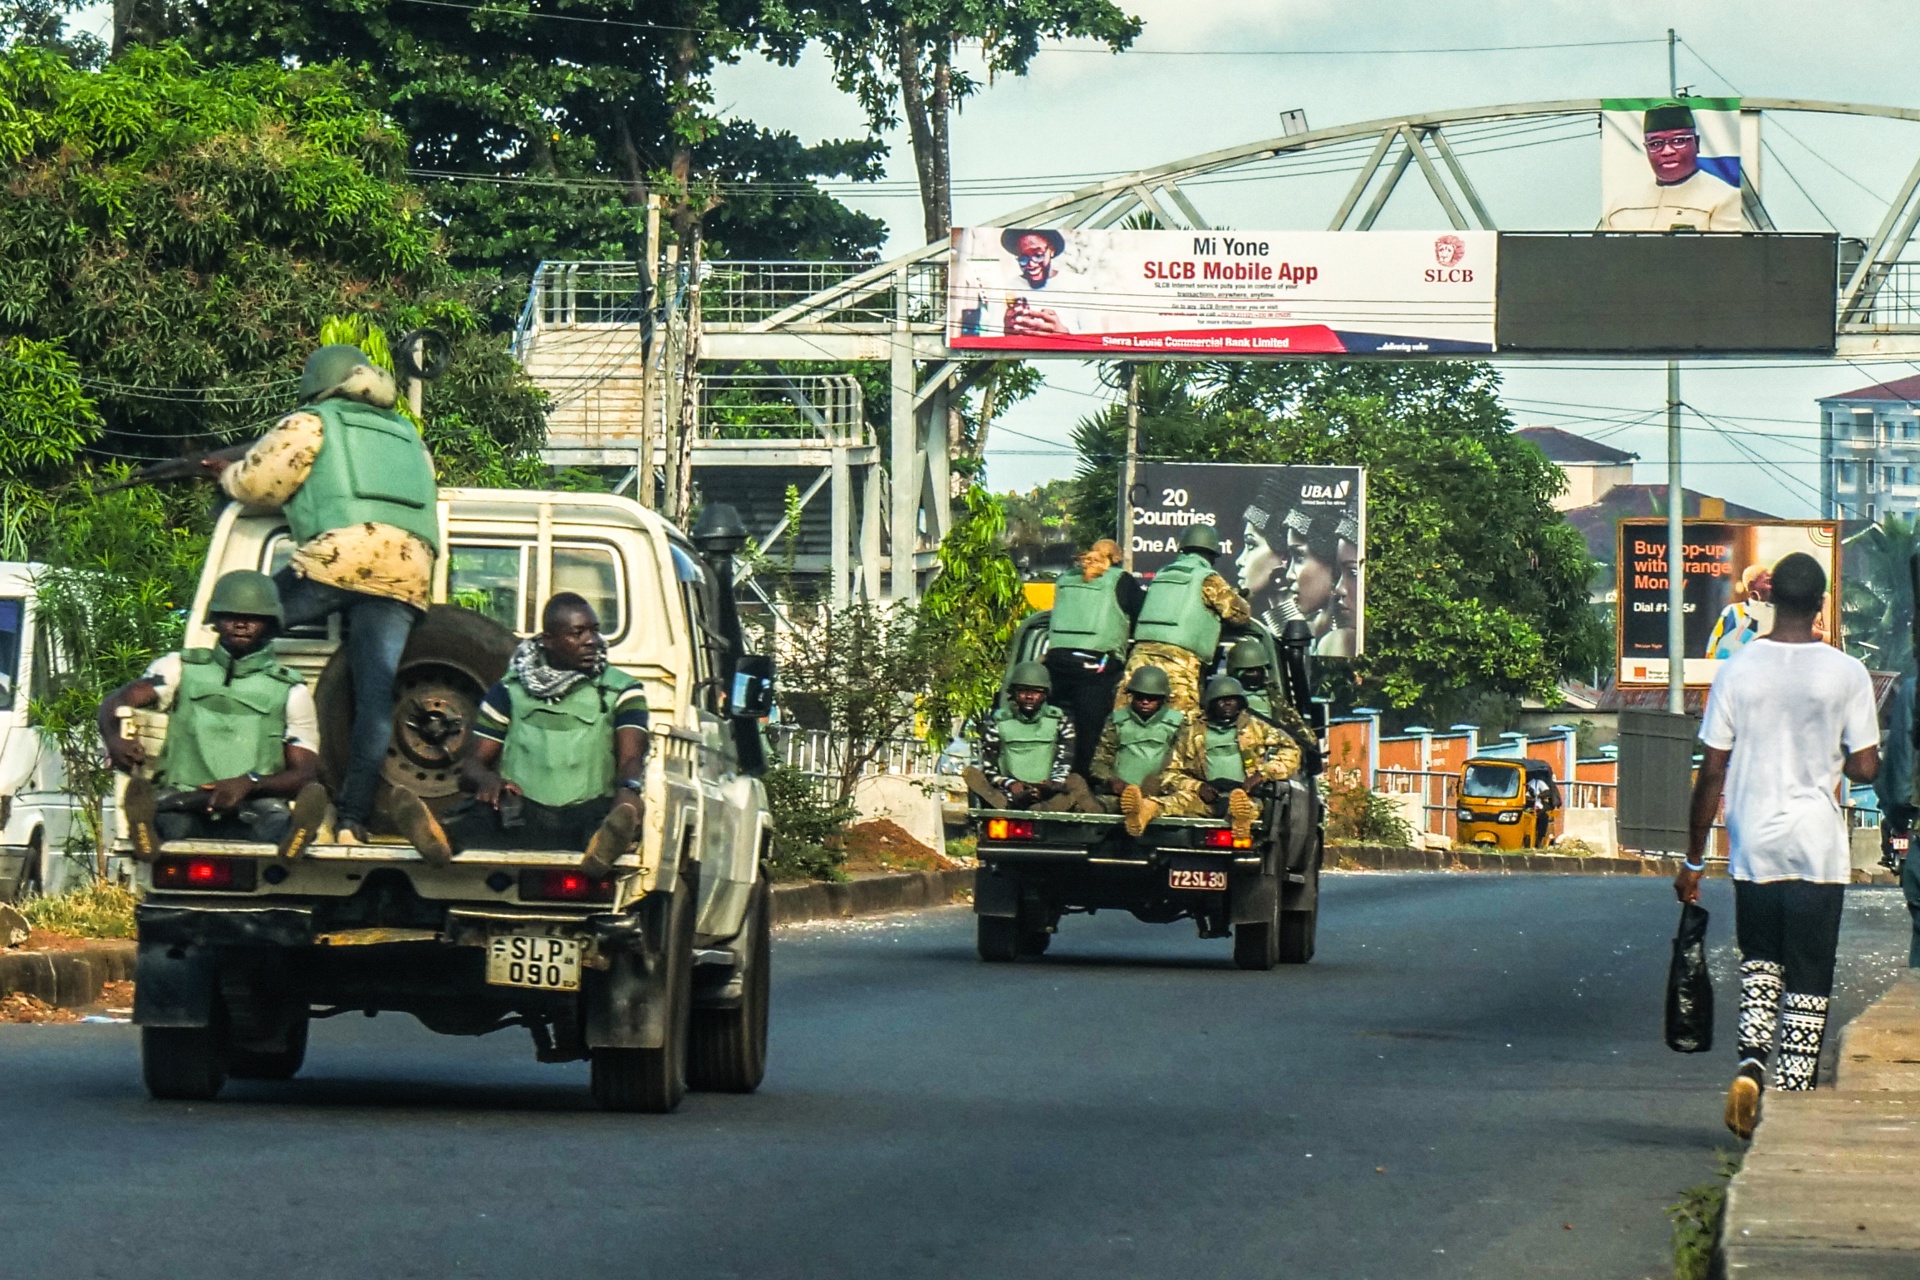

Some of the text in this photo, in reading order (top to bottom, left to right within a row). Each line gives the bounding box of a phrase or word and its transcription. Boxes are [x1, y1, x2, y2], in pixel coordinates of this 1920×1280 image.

[1193, 238, 1270, 256] Mi Yone
[1143, 261, 1319, 285] SLCB Mobile App
[1424, 269, 1474, 283] SLCB
[1250, 292, 1276, 300] anytime.
[1102, 336, 1132, 346] Sierra
[1133, 336, 1163, 347] Leone
[1164, 336, 1223, 348] Commercial
[1252, 337, 1290, 348] Limited
[1162, 488, 1189, 507] 20
[1301, 485, 1333, 498] UBA
[1133, 507, 1217, 527] Countries
[1132, 536, 1164, 553] One
[1634, 540, 1727, 559] Buy op-up
[1634, 559, 1733, 577] with range
[1634, 575, 1689, 590] Mony
[1633, 602, 1654, 612] Dial
[511, 937, 563, 963] SLP
[509, 962, 561, 987] 090
